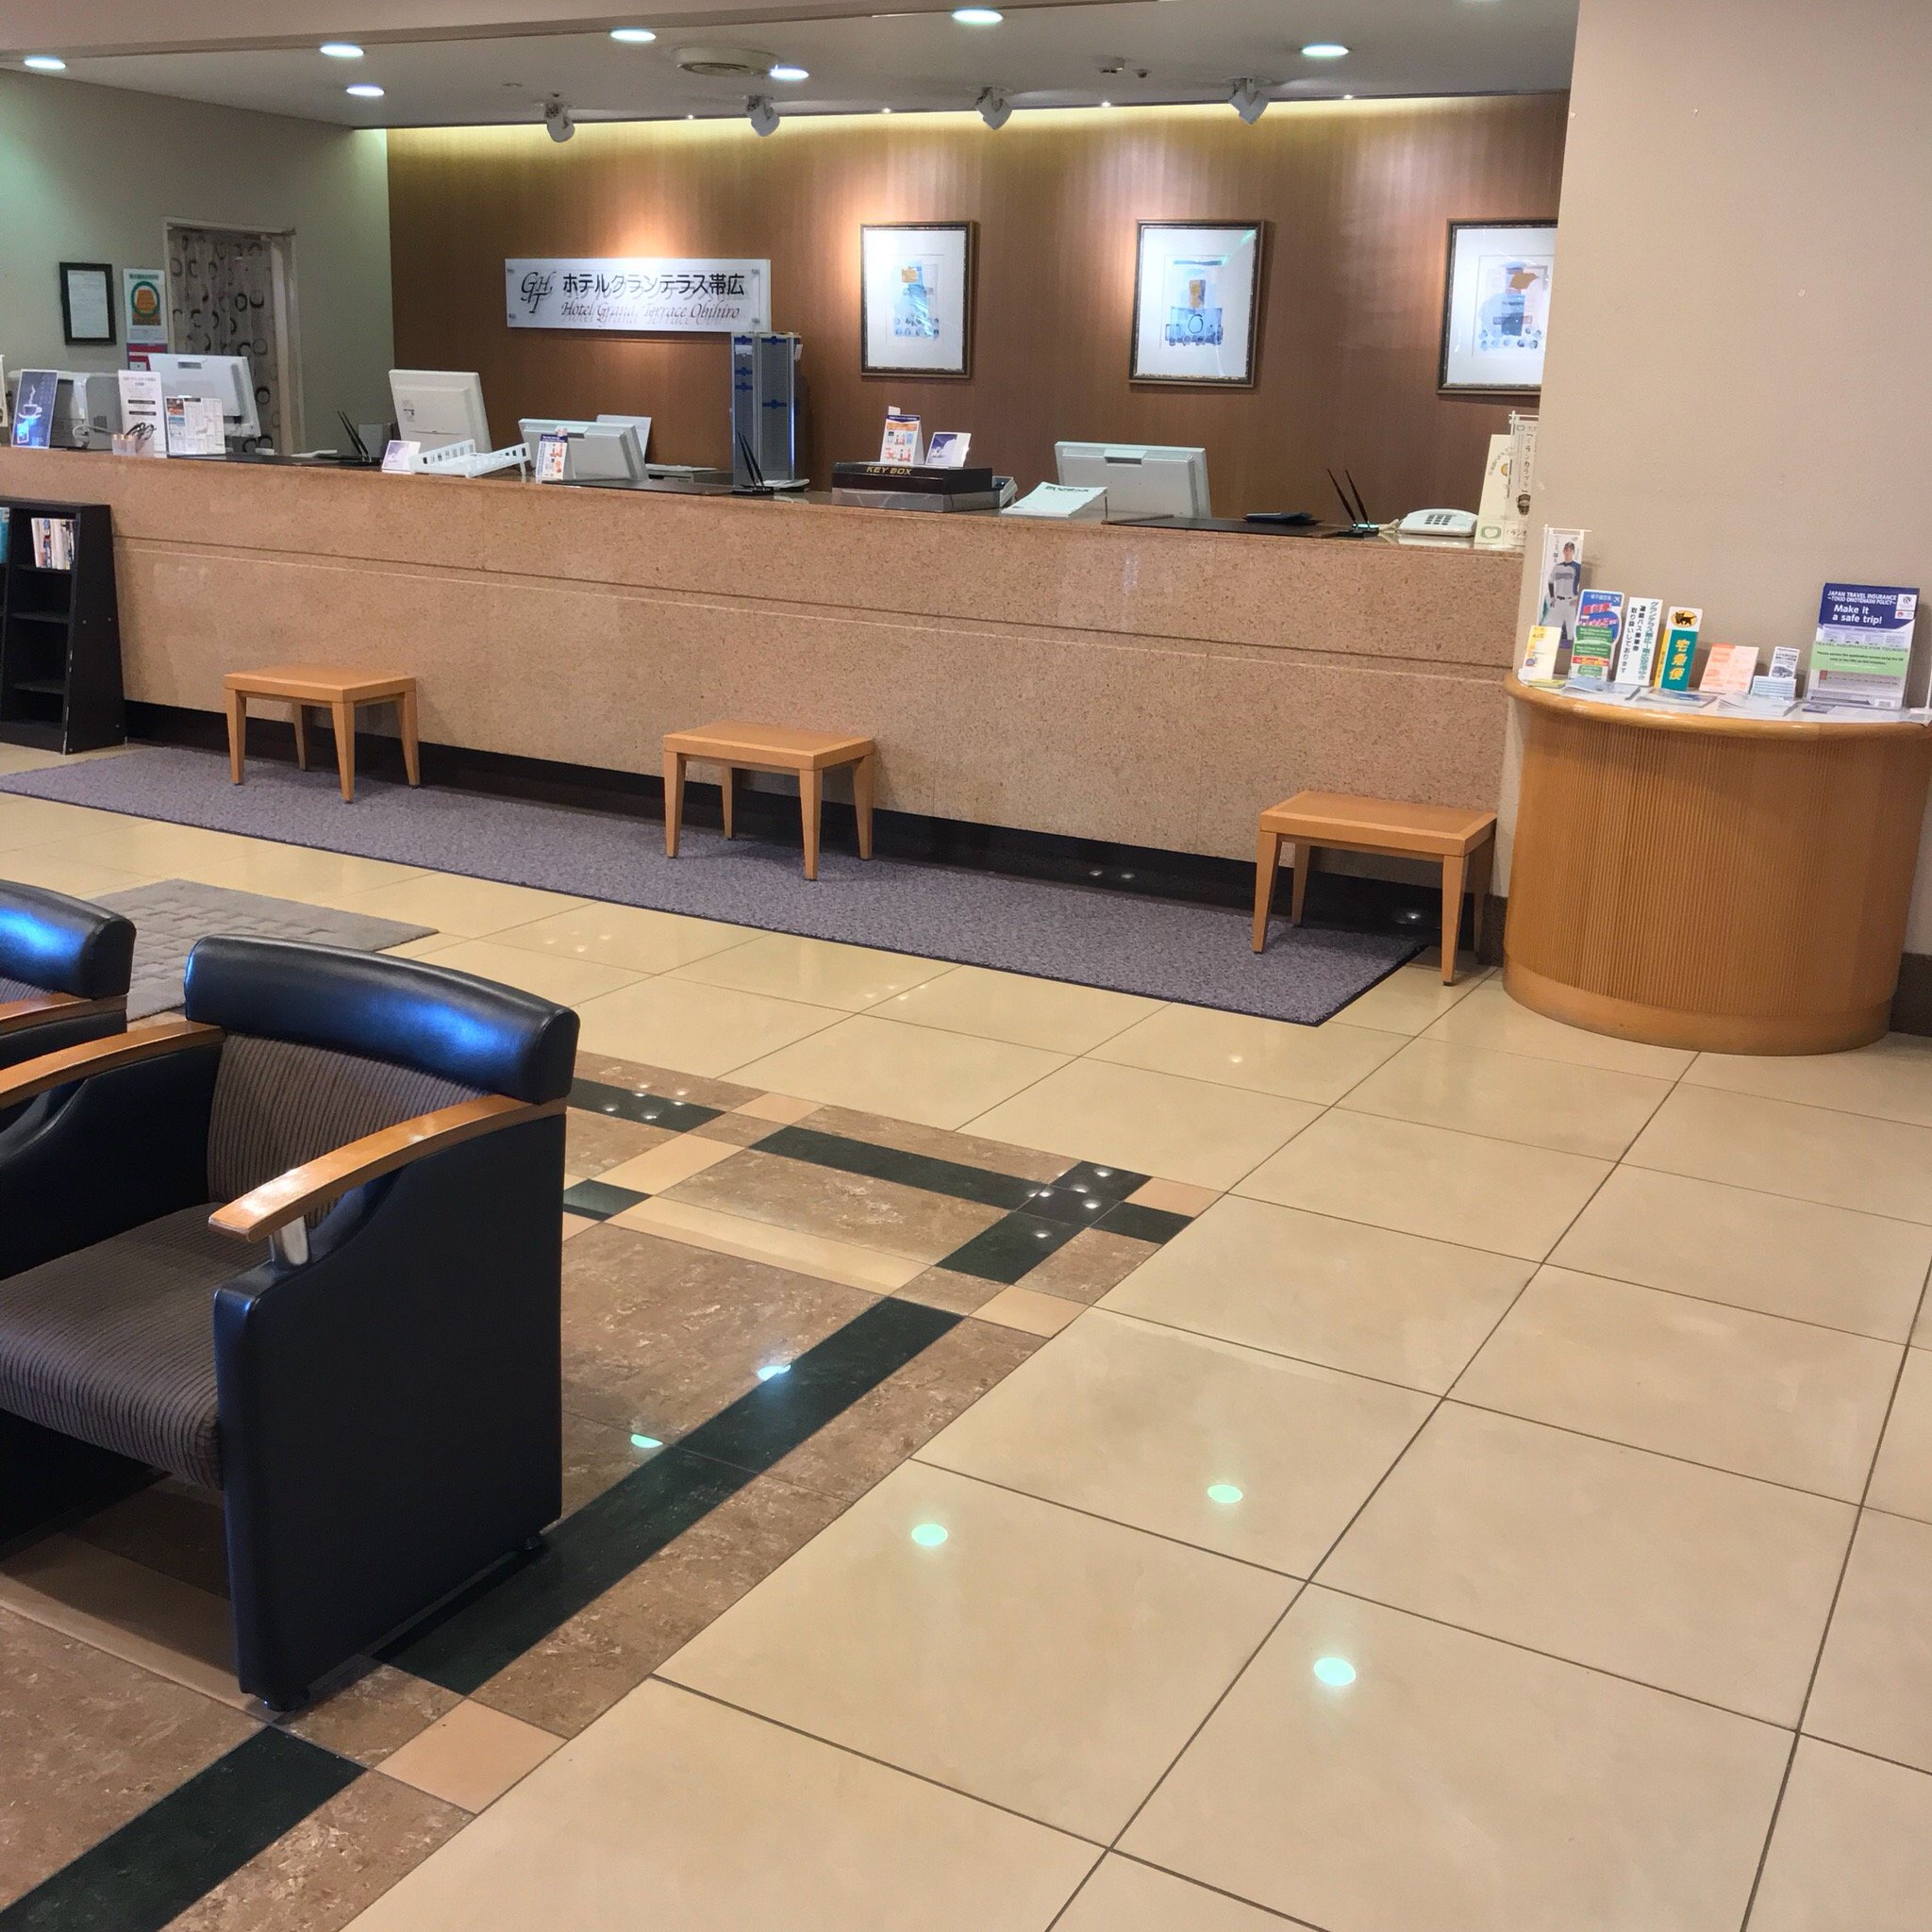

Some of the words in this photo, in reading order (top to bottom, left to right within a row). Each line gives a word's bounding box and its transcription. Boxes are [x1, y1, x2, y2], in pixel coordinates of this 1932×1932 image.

[560, 302, 594, 318] Hotel
[690, 299, 741, 319] Obihiro
[890, 467, 913, 475] BOX
[1833, 604, 1859, 613] Make
[1861, 606, 1870, 614] it
[1840, 613, 1860, 623] safe
[1862, 615, 1883, 625] trip!
